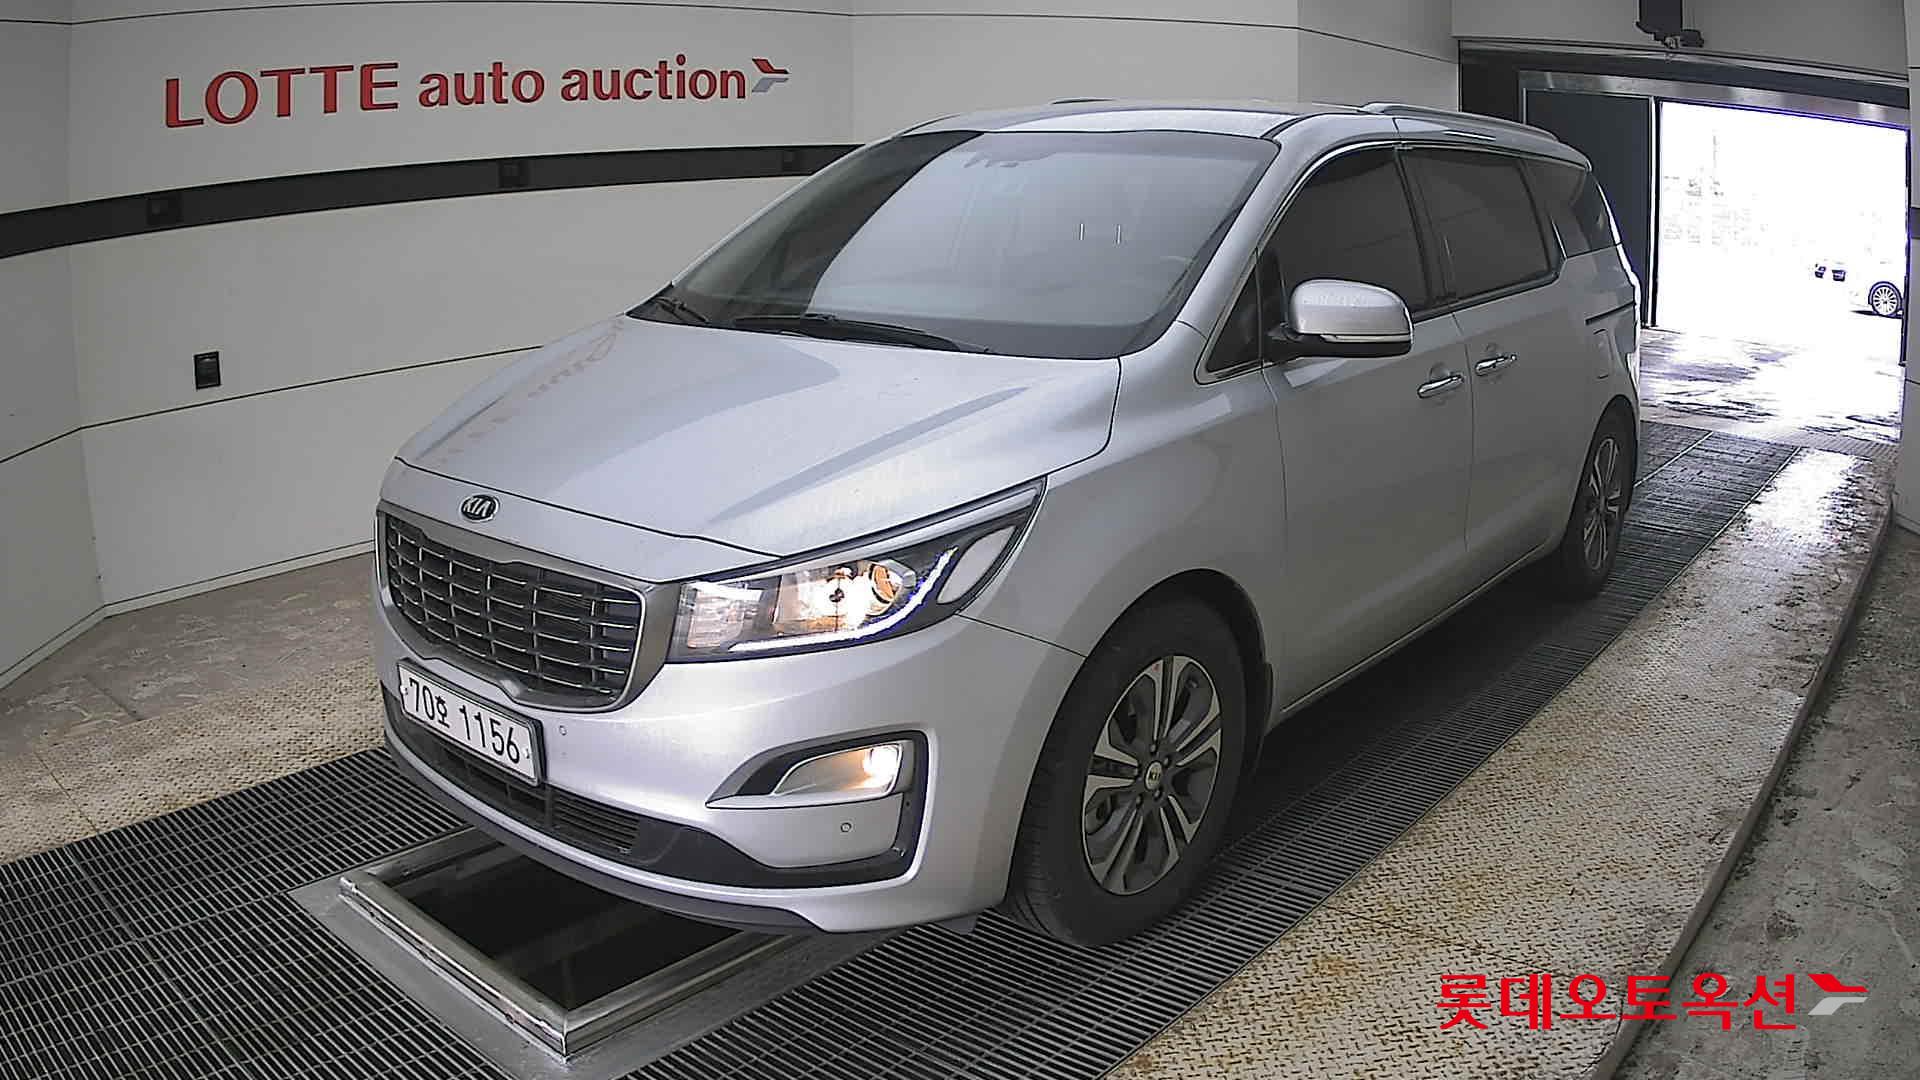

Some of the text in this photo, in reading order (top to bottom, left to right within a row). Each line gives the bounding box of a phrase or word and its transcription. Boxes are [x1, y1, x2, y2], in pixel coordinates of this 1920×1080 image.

[165, 54, 747, 129] LOTTE auto auction
[462, 495, 493, 517] KIA
[409, 677, 520, 764] 70호 1156
